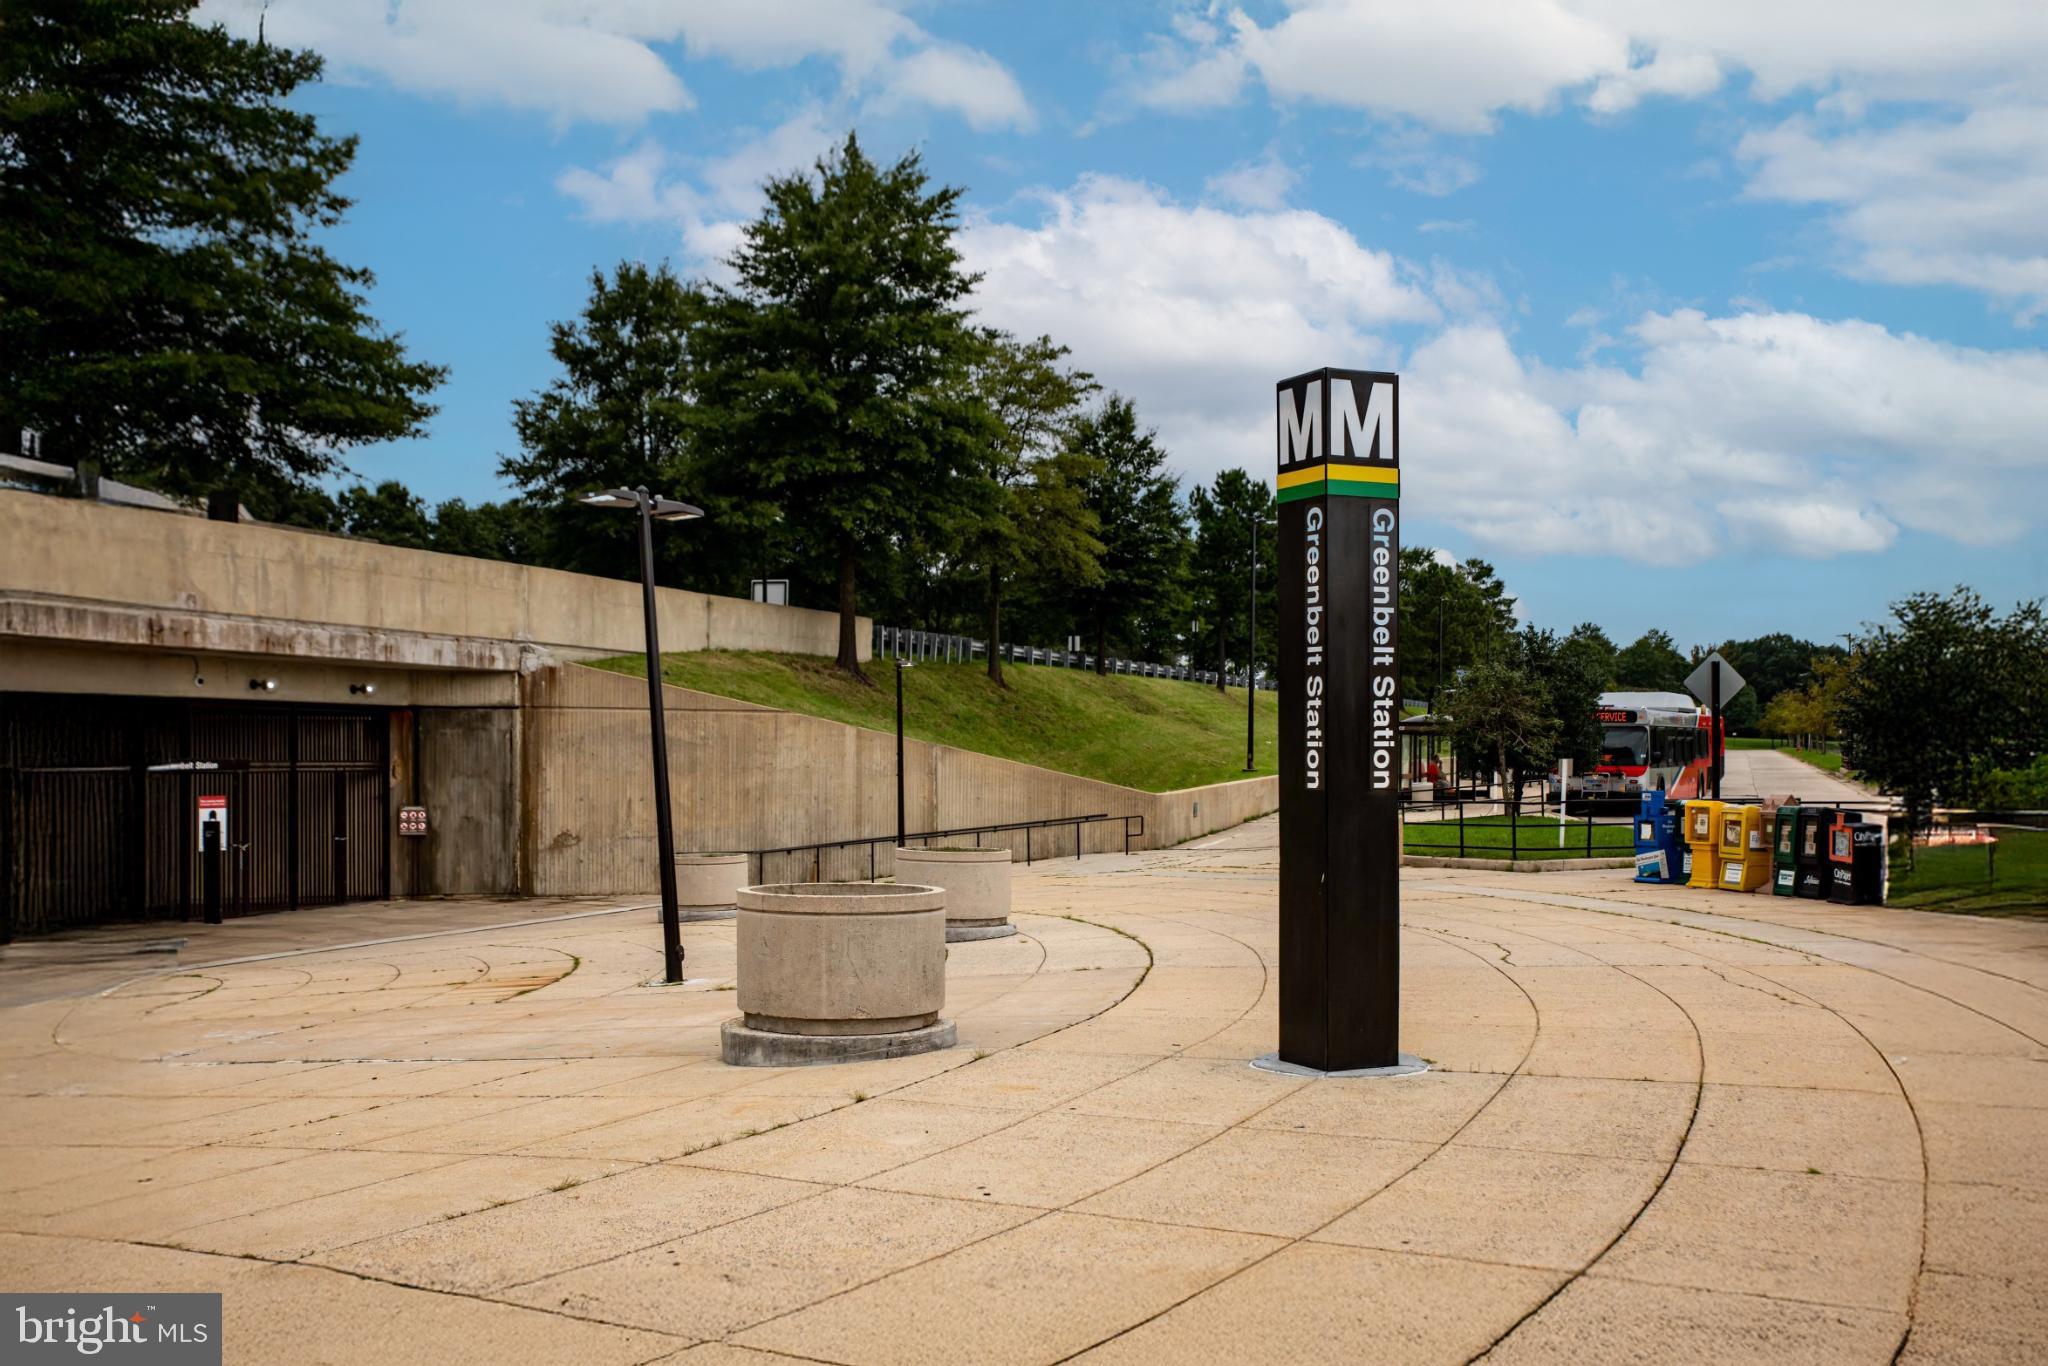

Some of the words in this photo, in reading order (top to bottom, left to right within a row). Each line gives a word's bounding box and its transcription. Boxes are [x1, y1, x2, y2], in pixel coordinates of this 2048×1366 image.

[1279, 379, 1323, 465] M
[1330, 378, 1394, 460] M
[1306, 506, 1323, 666] Greenbelt
[1372, 507, 1395, 666] Greenbelt
[1306, 675, 1323, 789] Station
[1372, 675, 1395, 789] Station
